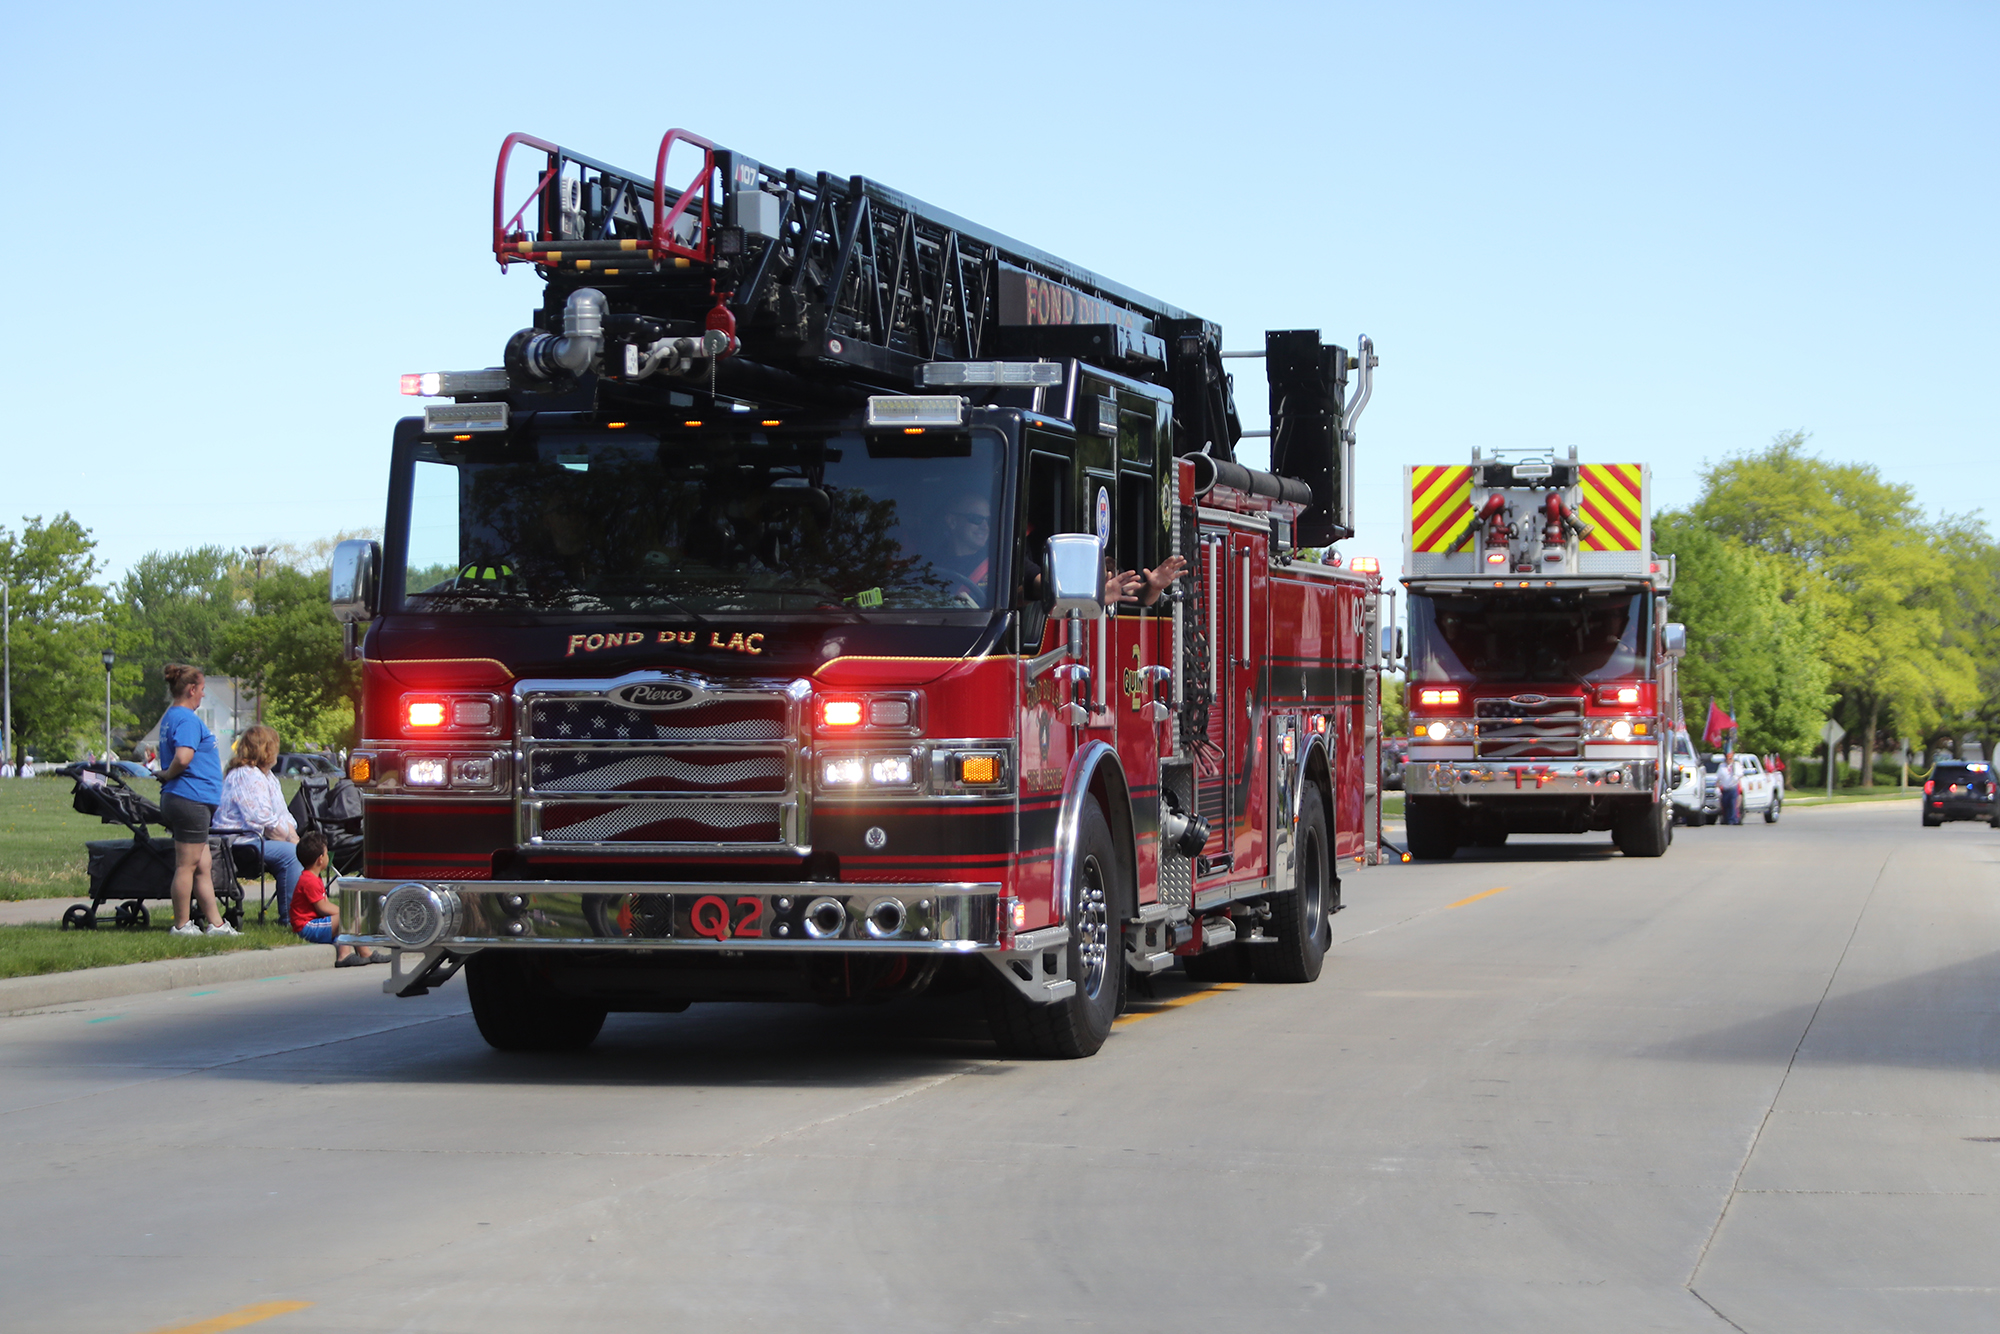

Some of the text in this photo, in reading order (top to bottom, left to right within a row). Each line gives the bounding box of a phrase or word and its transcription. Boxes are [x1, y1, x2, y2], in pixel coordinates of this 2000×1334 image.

[1026, 275, 1074, 325] FOND
[1353, 596, 1364, 637] Q2
[565, 631, 765, 657] FOND DU LAC
[629, 684, 683, 703] Pierce
[1508, 765, 1551, 789] T7
[690, 895, 763, 942] Q2
